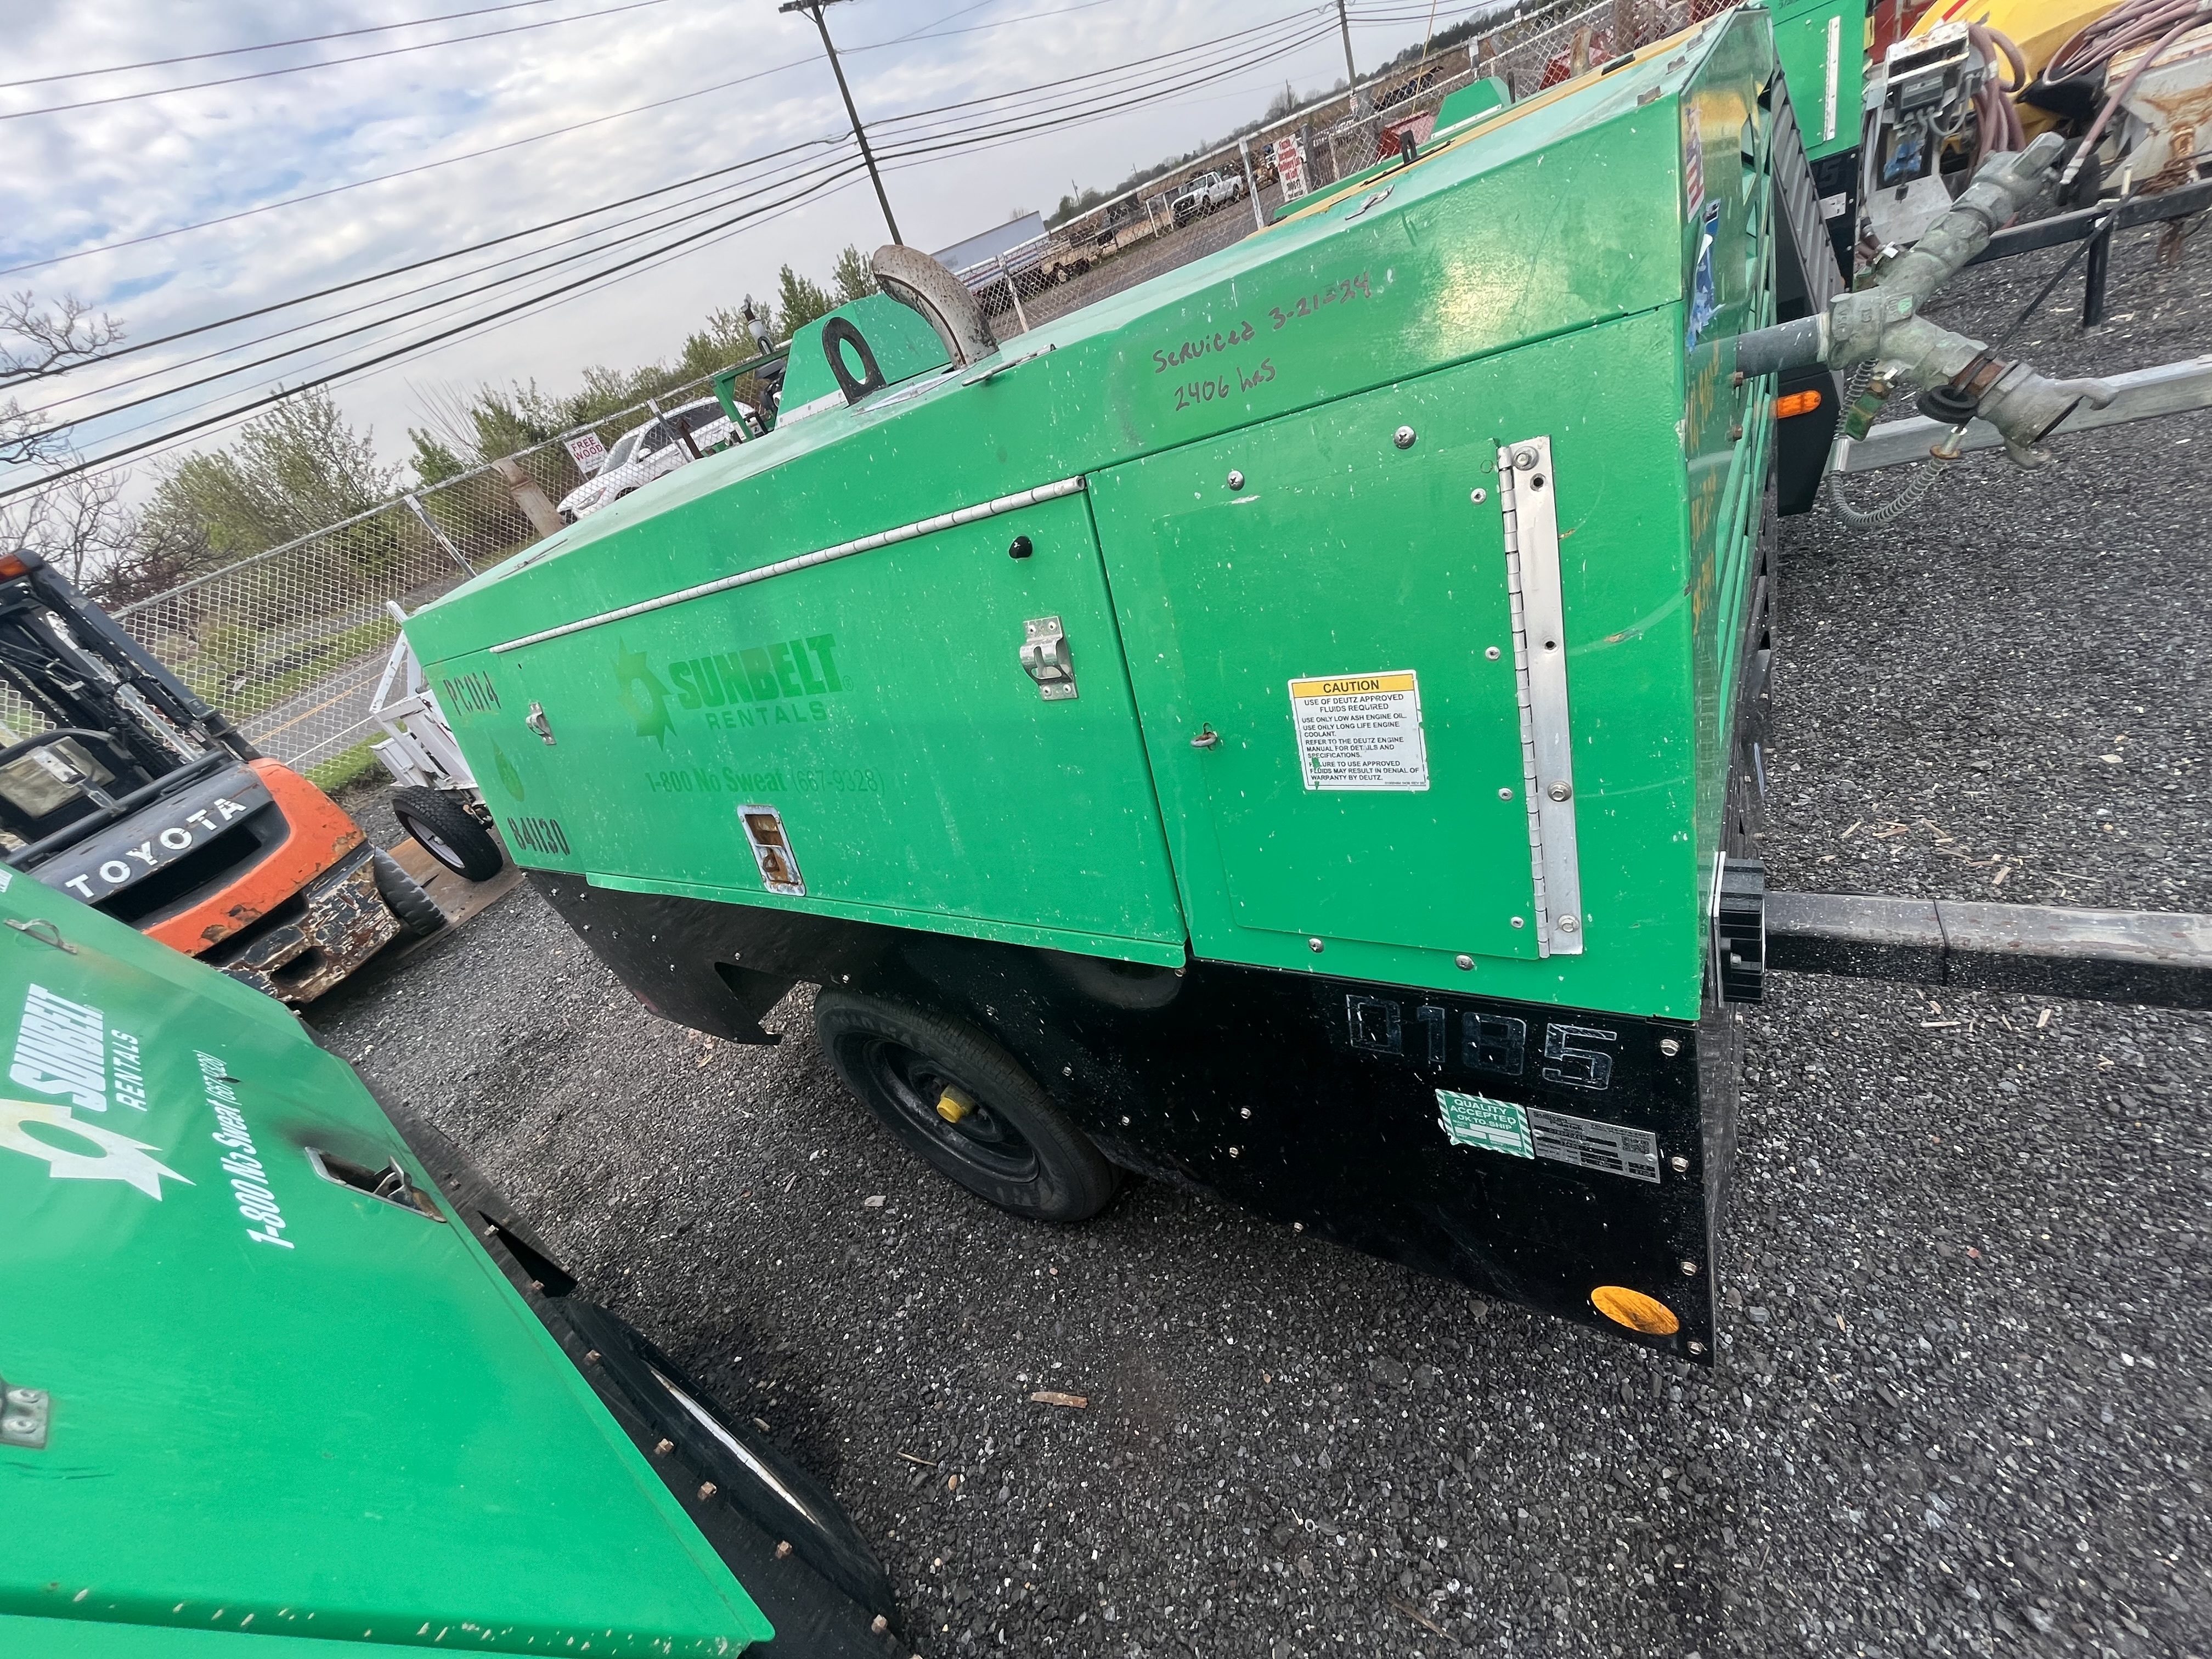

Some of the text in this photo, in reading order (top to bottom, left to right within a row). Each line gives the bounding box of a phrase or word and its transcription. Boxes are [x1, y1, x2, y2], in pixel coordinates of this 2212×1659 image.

[1174, 375, 1229, 411] 2406
[571, 437, 596, 452] FREE
[573, 444, 603, 461] WOOD
[669, 633, 844, 710] SUNBELT
[1323, 680, 1379, 693] CAUTION
[705, 701, 827, 730] RENTALS
[645, 770, 691, 792] 1-800
[693, 768, 721, 792] No
[722, 767, 788, 792] Sweat
[65, 798, 247, 898] TOYOTA
[9, 983, 108, 1112] SUNBELT
[111, 1029, 147, 1111] RENTALS
[1450, 1105, 1516, 1125] ACCEPTED
[1454, 1098, 1506, 1115] QUALITY
[206, 1098, 257, 1155] Sweat
[1474, 1117, 1487, 1125] TO
[1488, 1120, 1512, 1130] SHIP
[220, 1152, 269, 1185] No
[231, 1178, 295, 1249] 1-800
